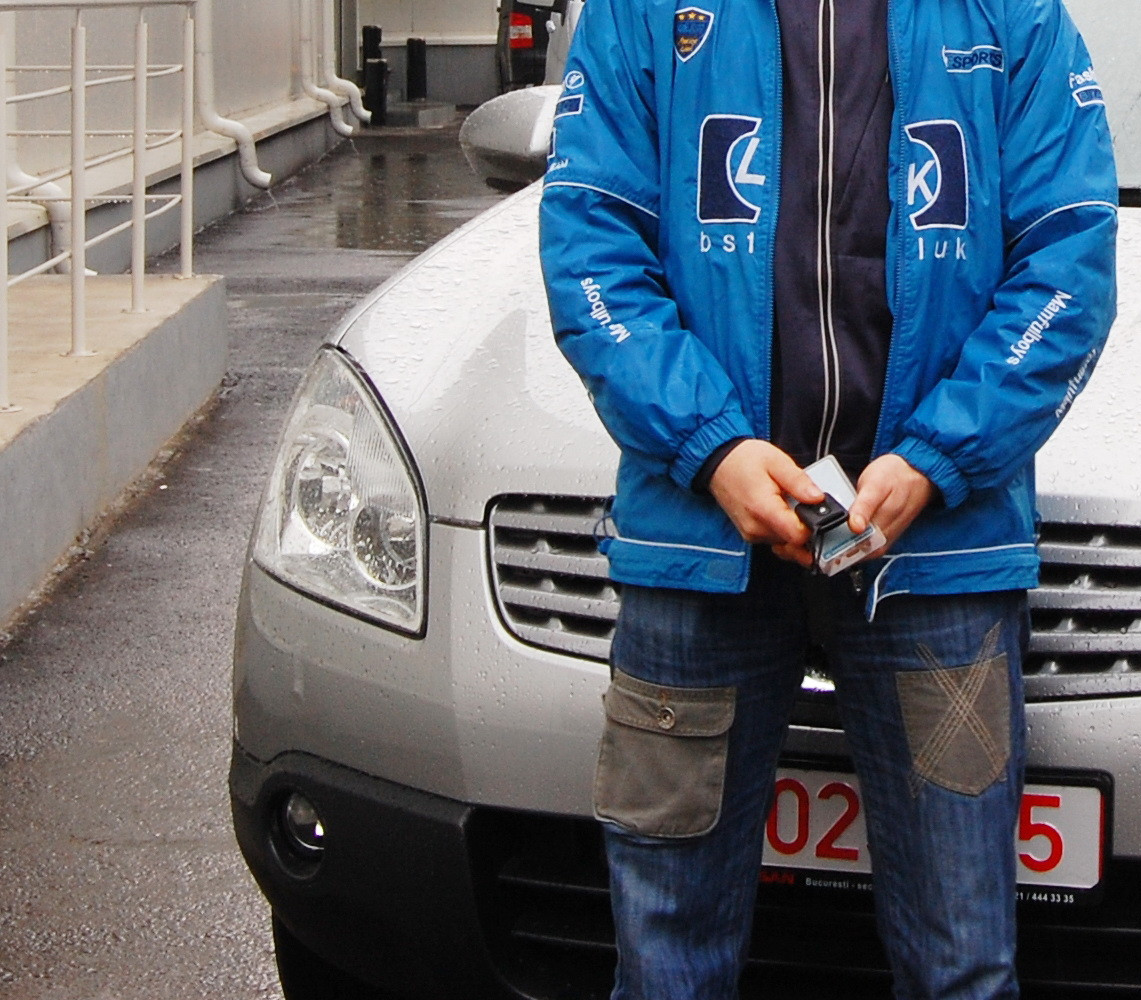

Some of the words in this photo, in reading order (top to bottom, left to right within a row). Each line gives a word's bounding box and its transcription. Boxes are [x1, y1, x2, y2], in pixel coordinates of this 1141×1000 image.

[735, 137, 766, 186] L
[1005, 290, 1073, 366] Manfulboys
[805, 877, 850, 889] Bucuresti
